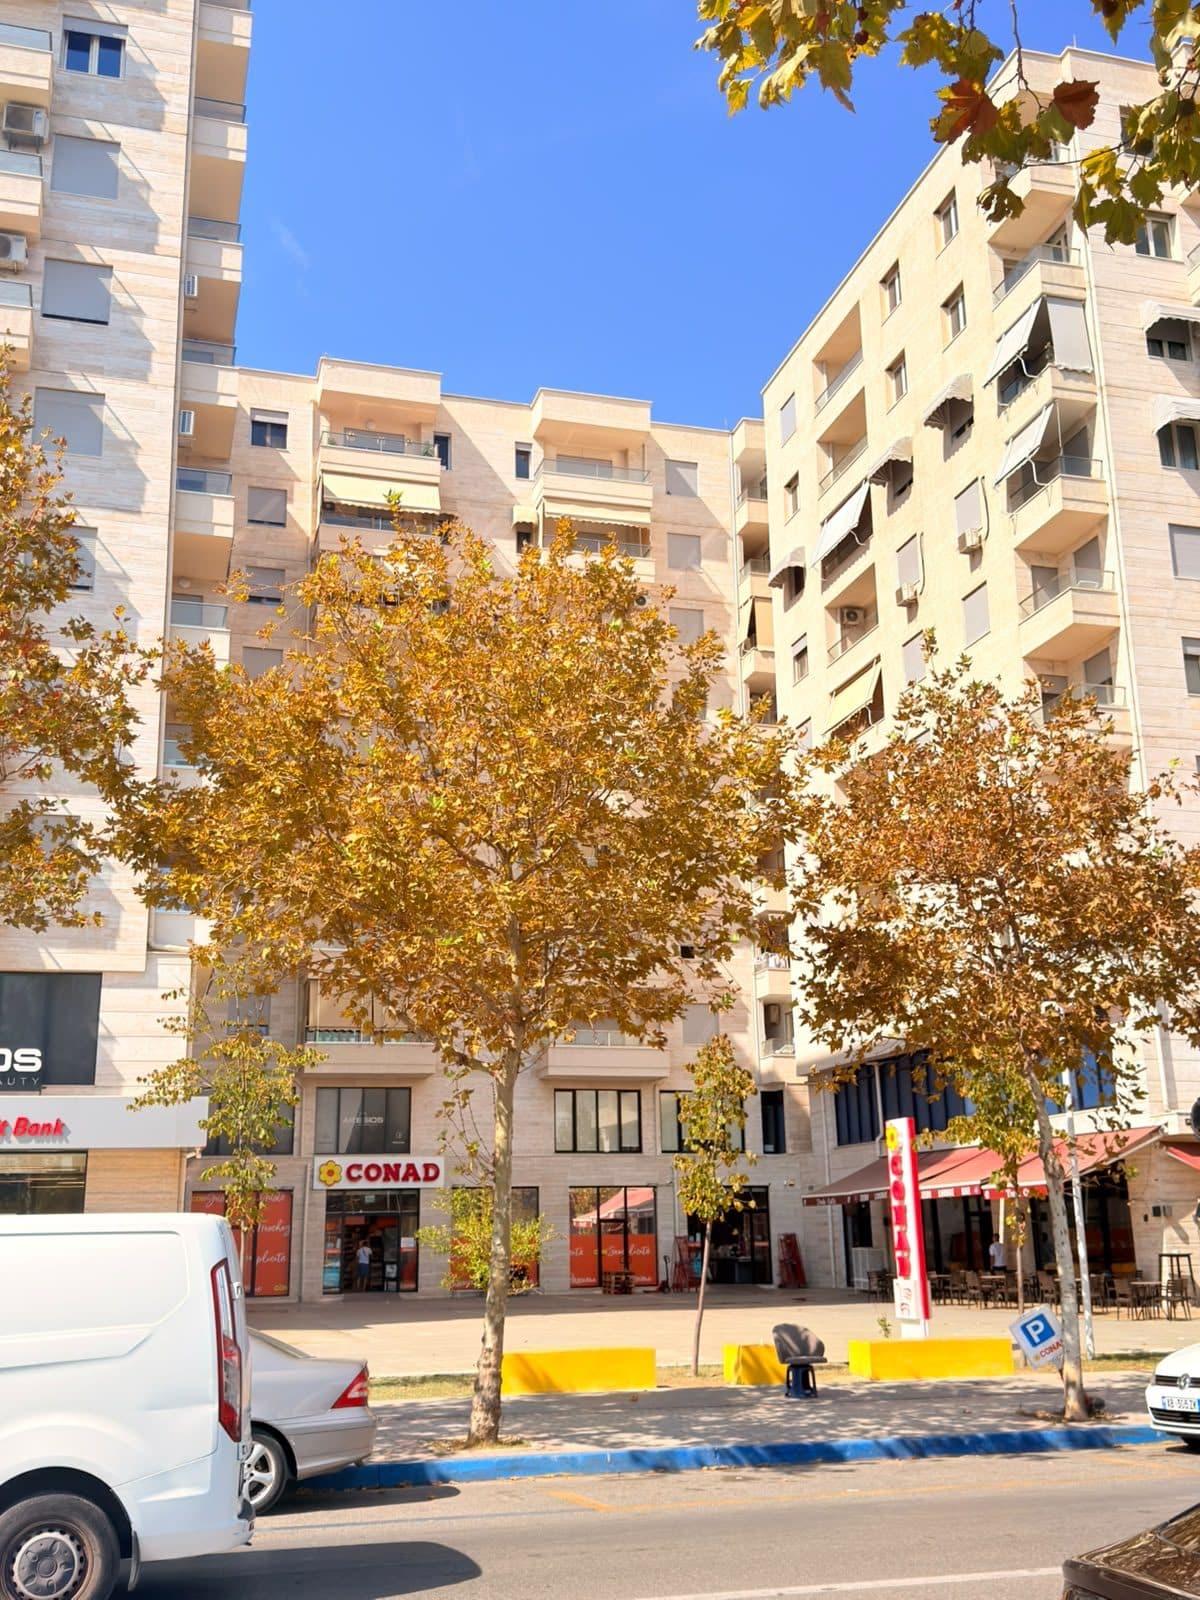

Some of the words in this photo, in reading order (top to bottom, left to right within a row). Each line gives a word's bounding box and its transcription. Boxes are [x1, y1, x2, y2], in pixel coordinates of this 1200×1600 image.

[0, 1077, 40, 1086] UTY
[13, 1117, 64, 1136] Bank
[346, 1163, 440, 1182] CONAD
[1025, 1320, 1044, 1344] P
